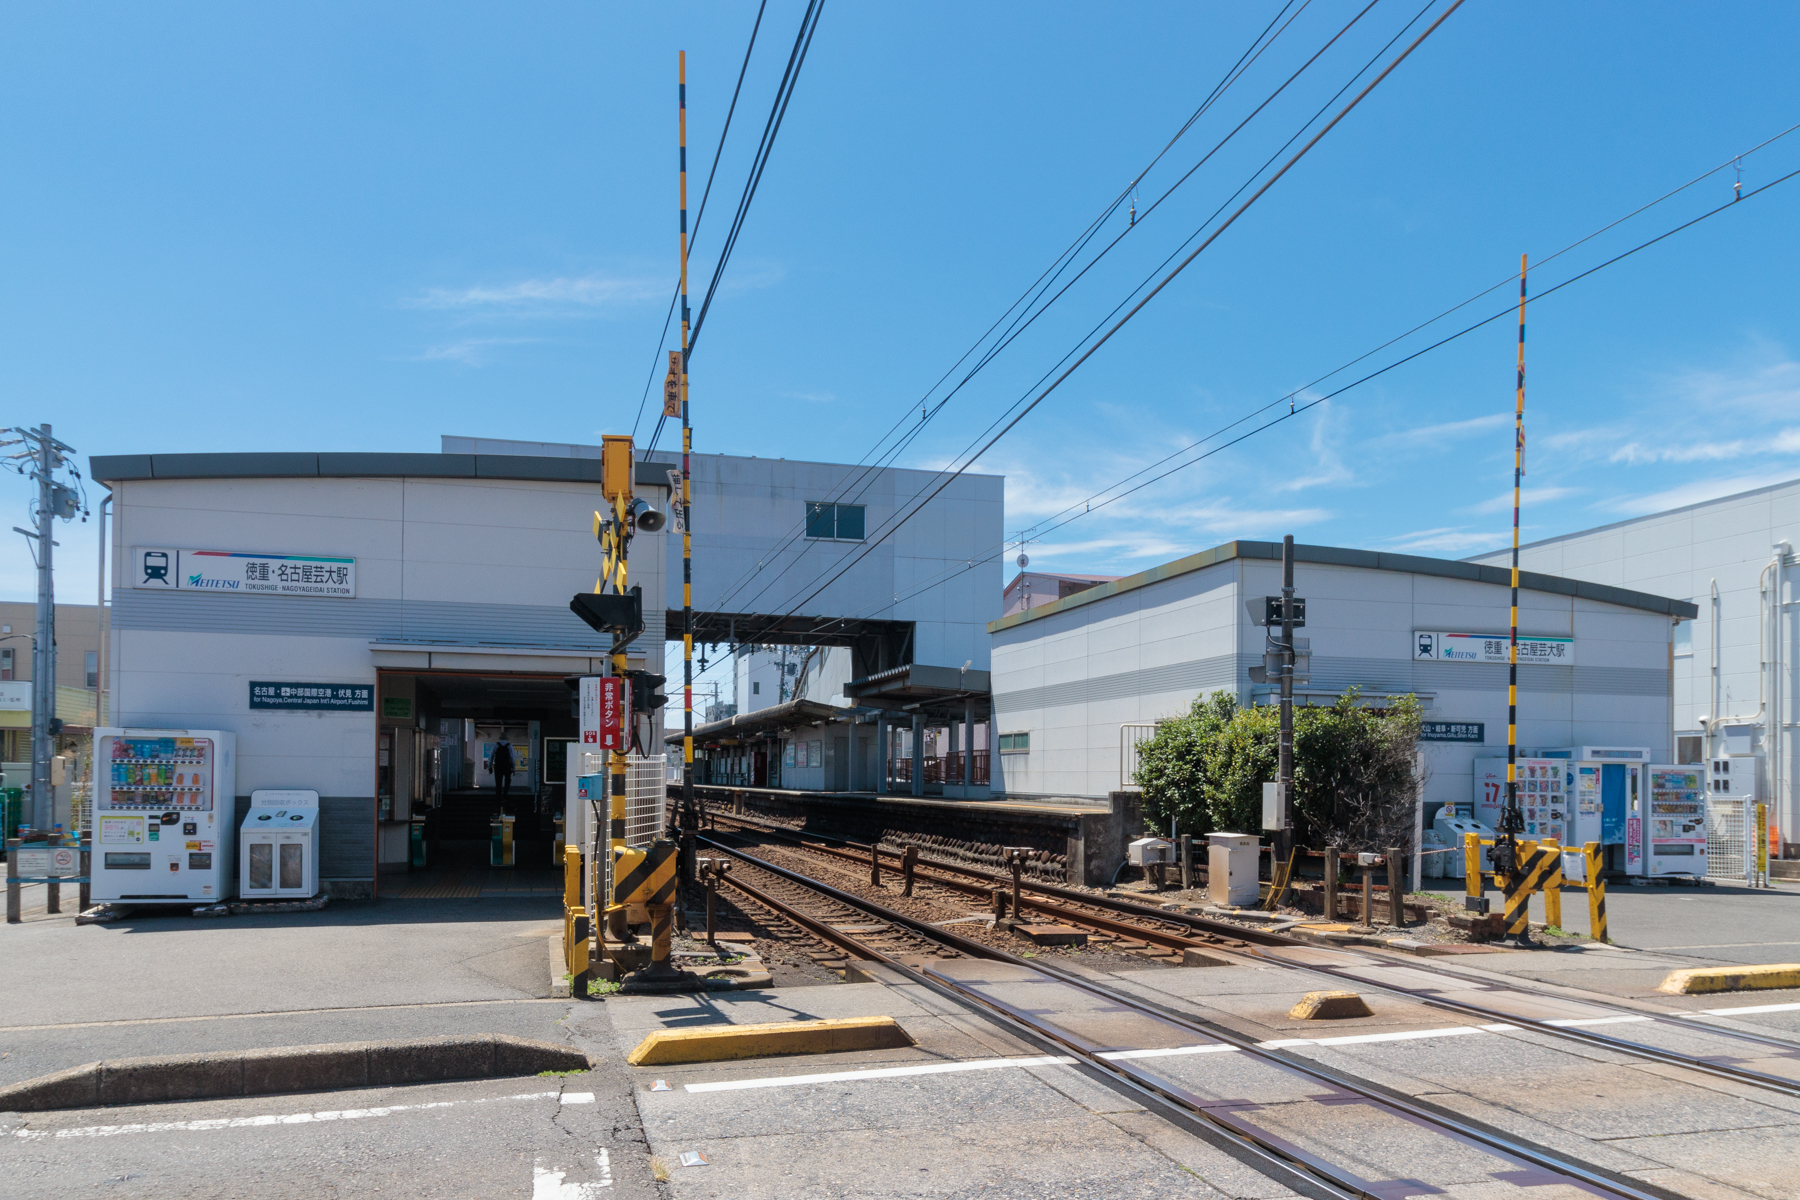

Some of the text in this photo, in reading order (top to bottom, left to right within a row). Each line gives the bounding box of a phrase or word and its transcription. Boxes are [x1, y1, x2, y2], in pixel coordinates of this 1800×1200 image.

[187, 572, 240, 589] MEITETSU
[245, 562, 348, 585] 徳重・名古屋芸大駅
[326, 587, 350, 595] STATION
[1444, 646, 1477, 659] MEITETSU
[354, 689, 369, 699] 方面
[604, 683, 614, 728] 非常ボタン
